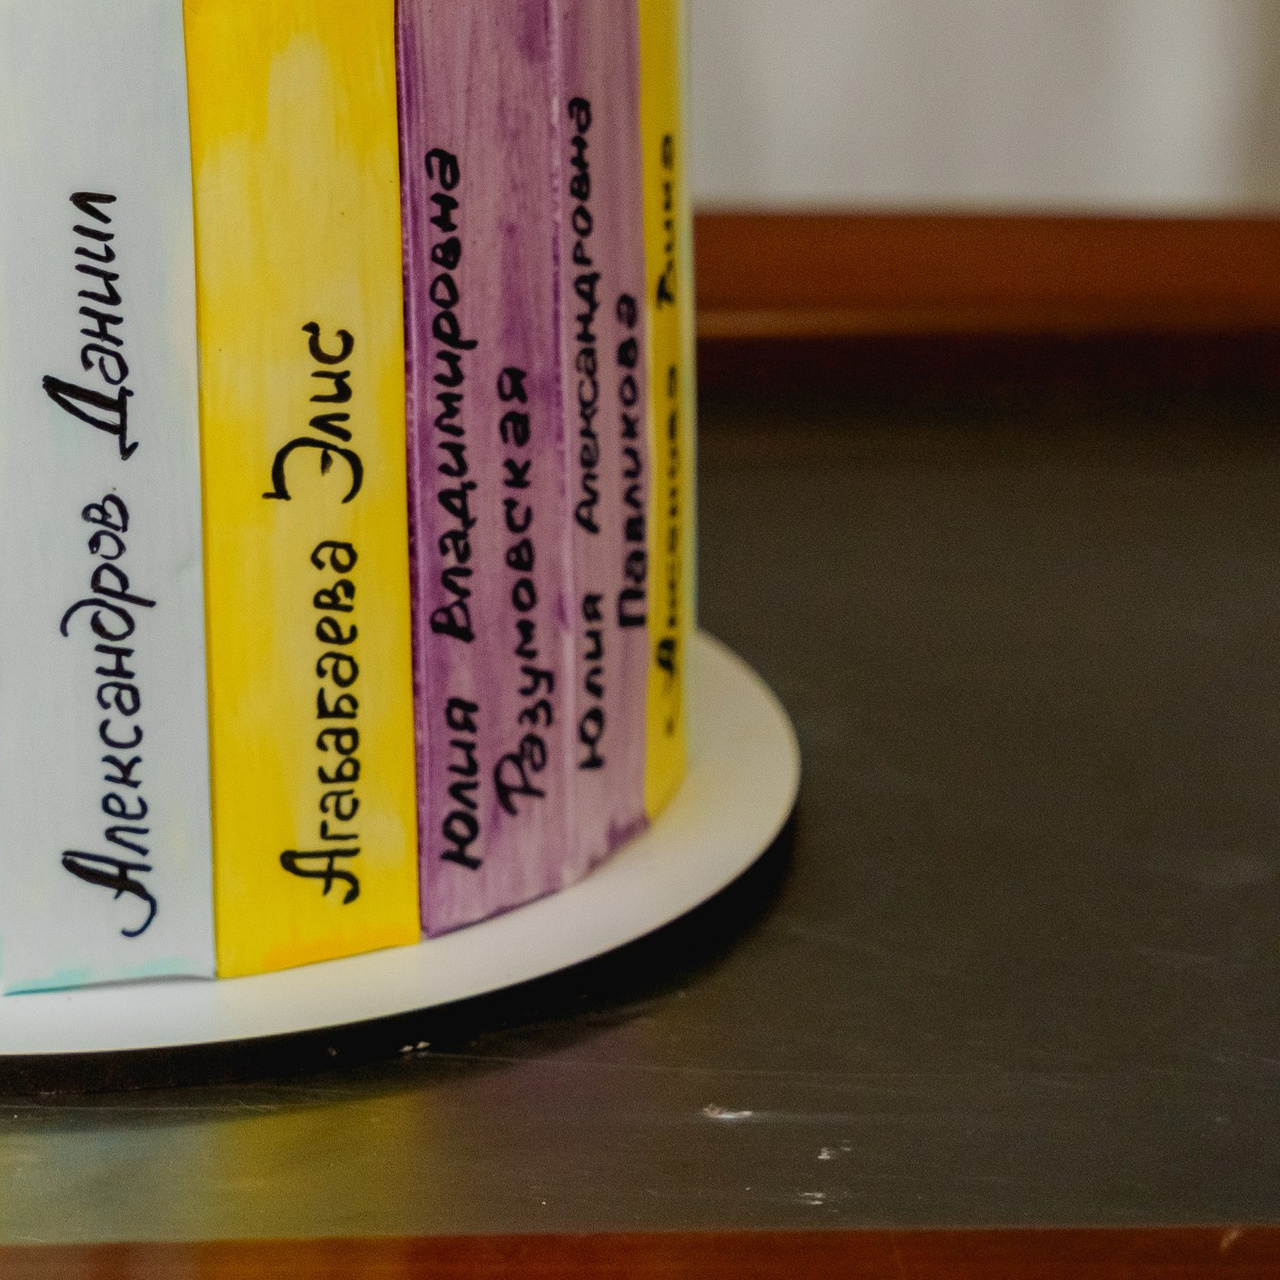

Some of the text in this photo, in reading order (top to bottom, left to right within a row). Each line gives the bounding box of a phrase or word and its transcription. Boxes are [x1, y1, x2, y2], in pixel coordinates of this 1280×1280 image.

[43, 192, 157, 937] Александров Даниил
[262, 322, 363, 904] Агабабаева Элис
[427, 147, 481, 871] Юлия Владимировна
[495, 368, 554, 816] Разумовская
[566, 96, 606, 771] Юлия Александровна
[615, 293, 649, 629] Павликова
